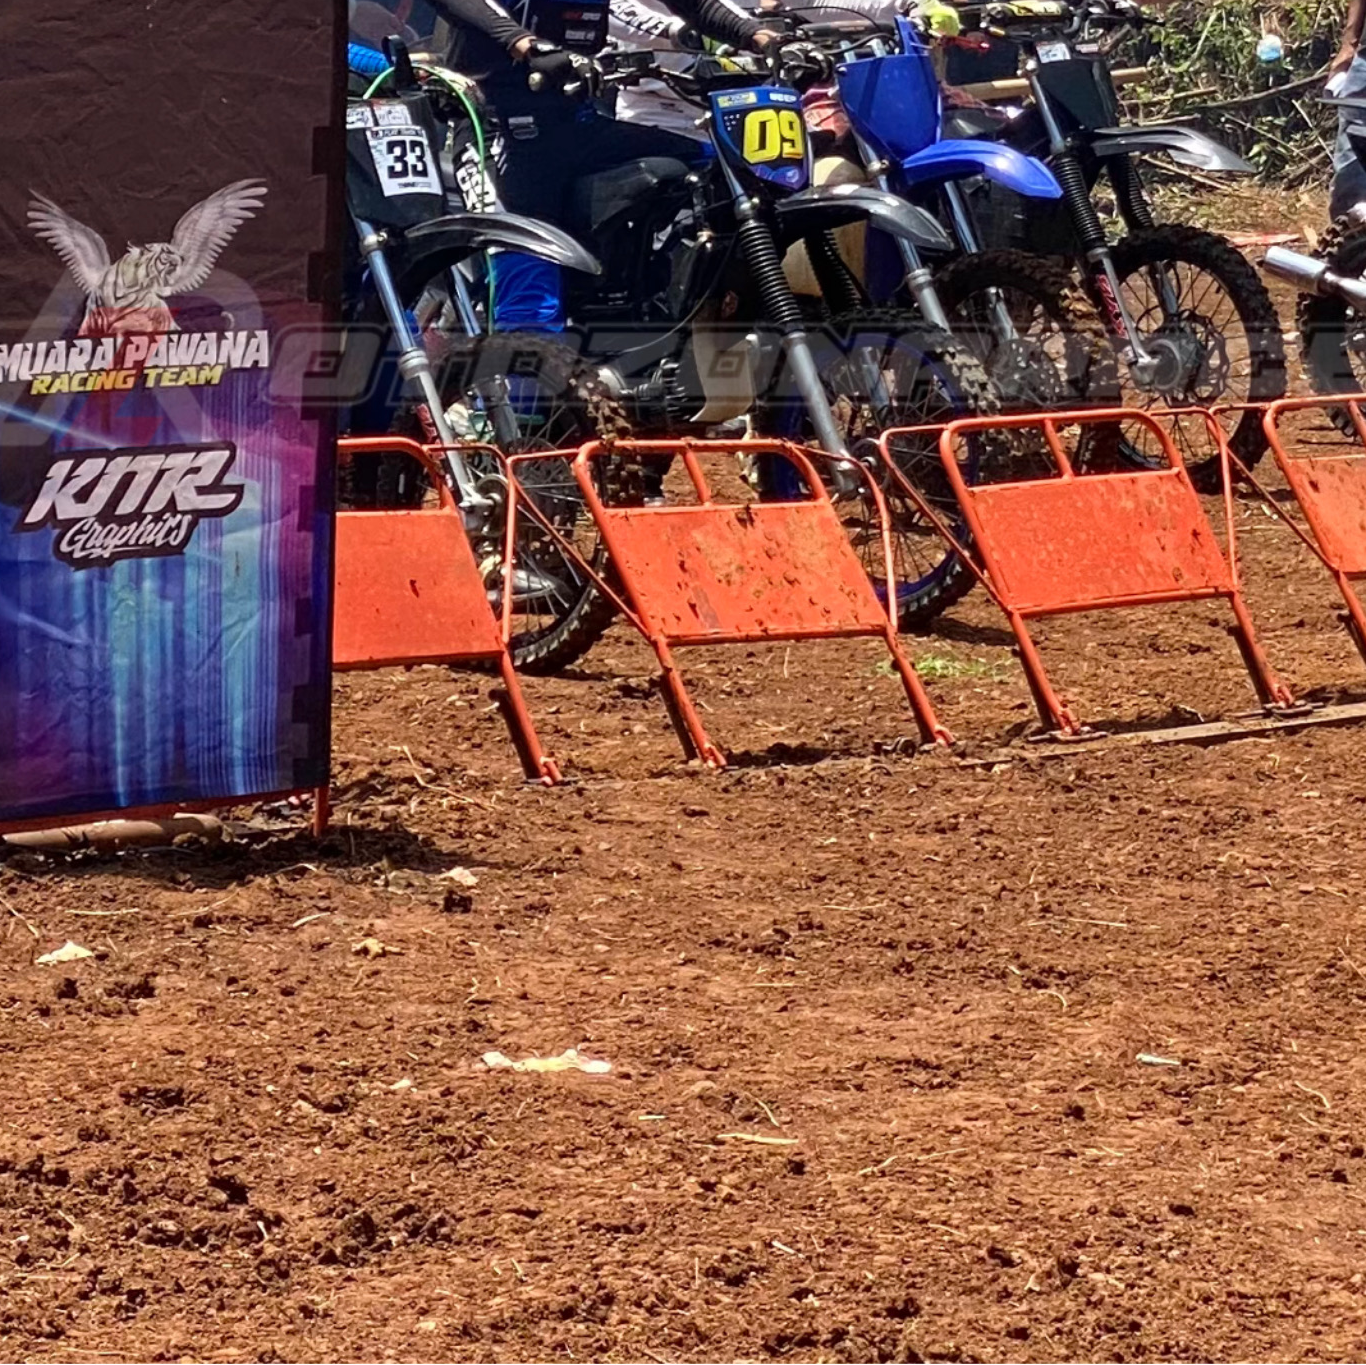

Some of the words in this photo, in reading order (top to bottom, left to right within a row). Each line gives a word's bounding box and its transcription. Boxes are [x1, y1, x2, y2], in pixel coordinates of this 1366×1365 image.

[743, 108, 804, 164] 09
[386, 139, 429, 179] 33
[124, 329, 271, 369] PAWANA
[30, 368, 135, 396] RACING
[143, 363, 225, 388] TEAM
[59, 515, 193, 559] Graphics
